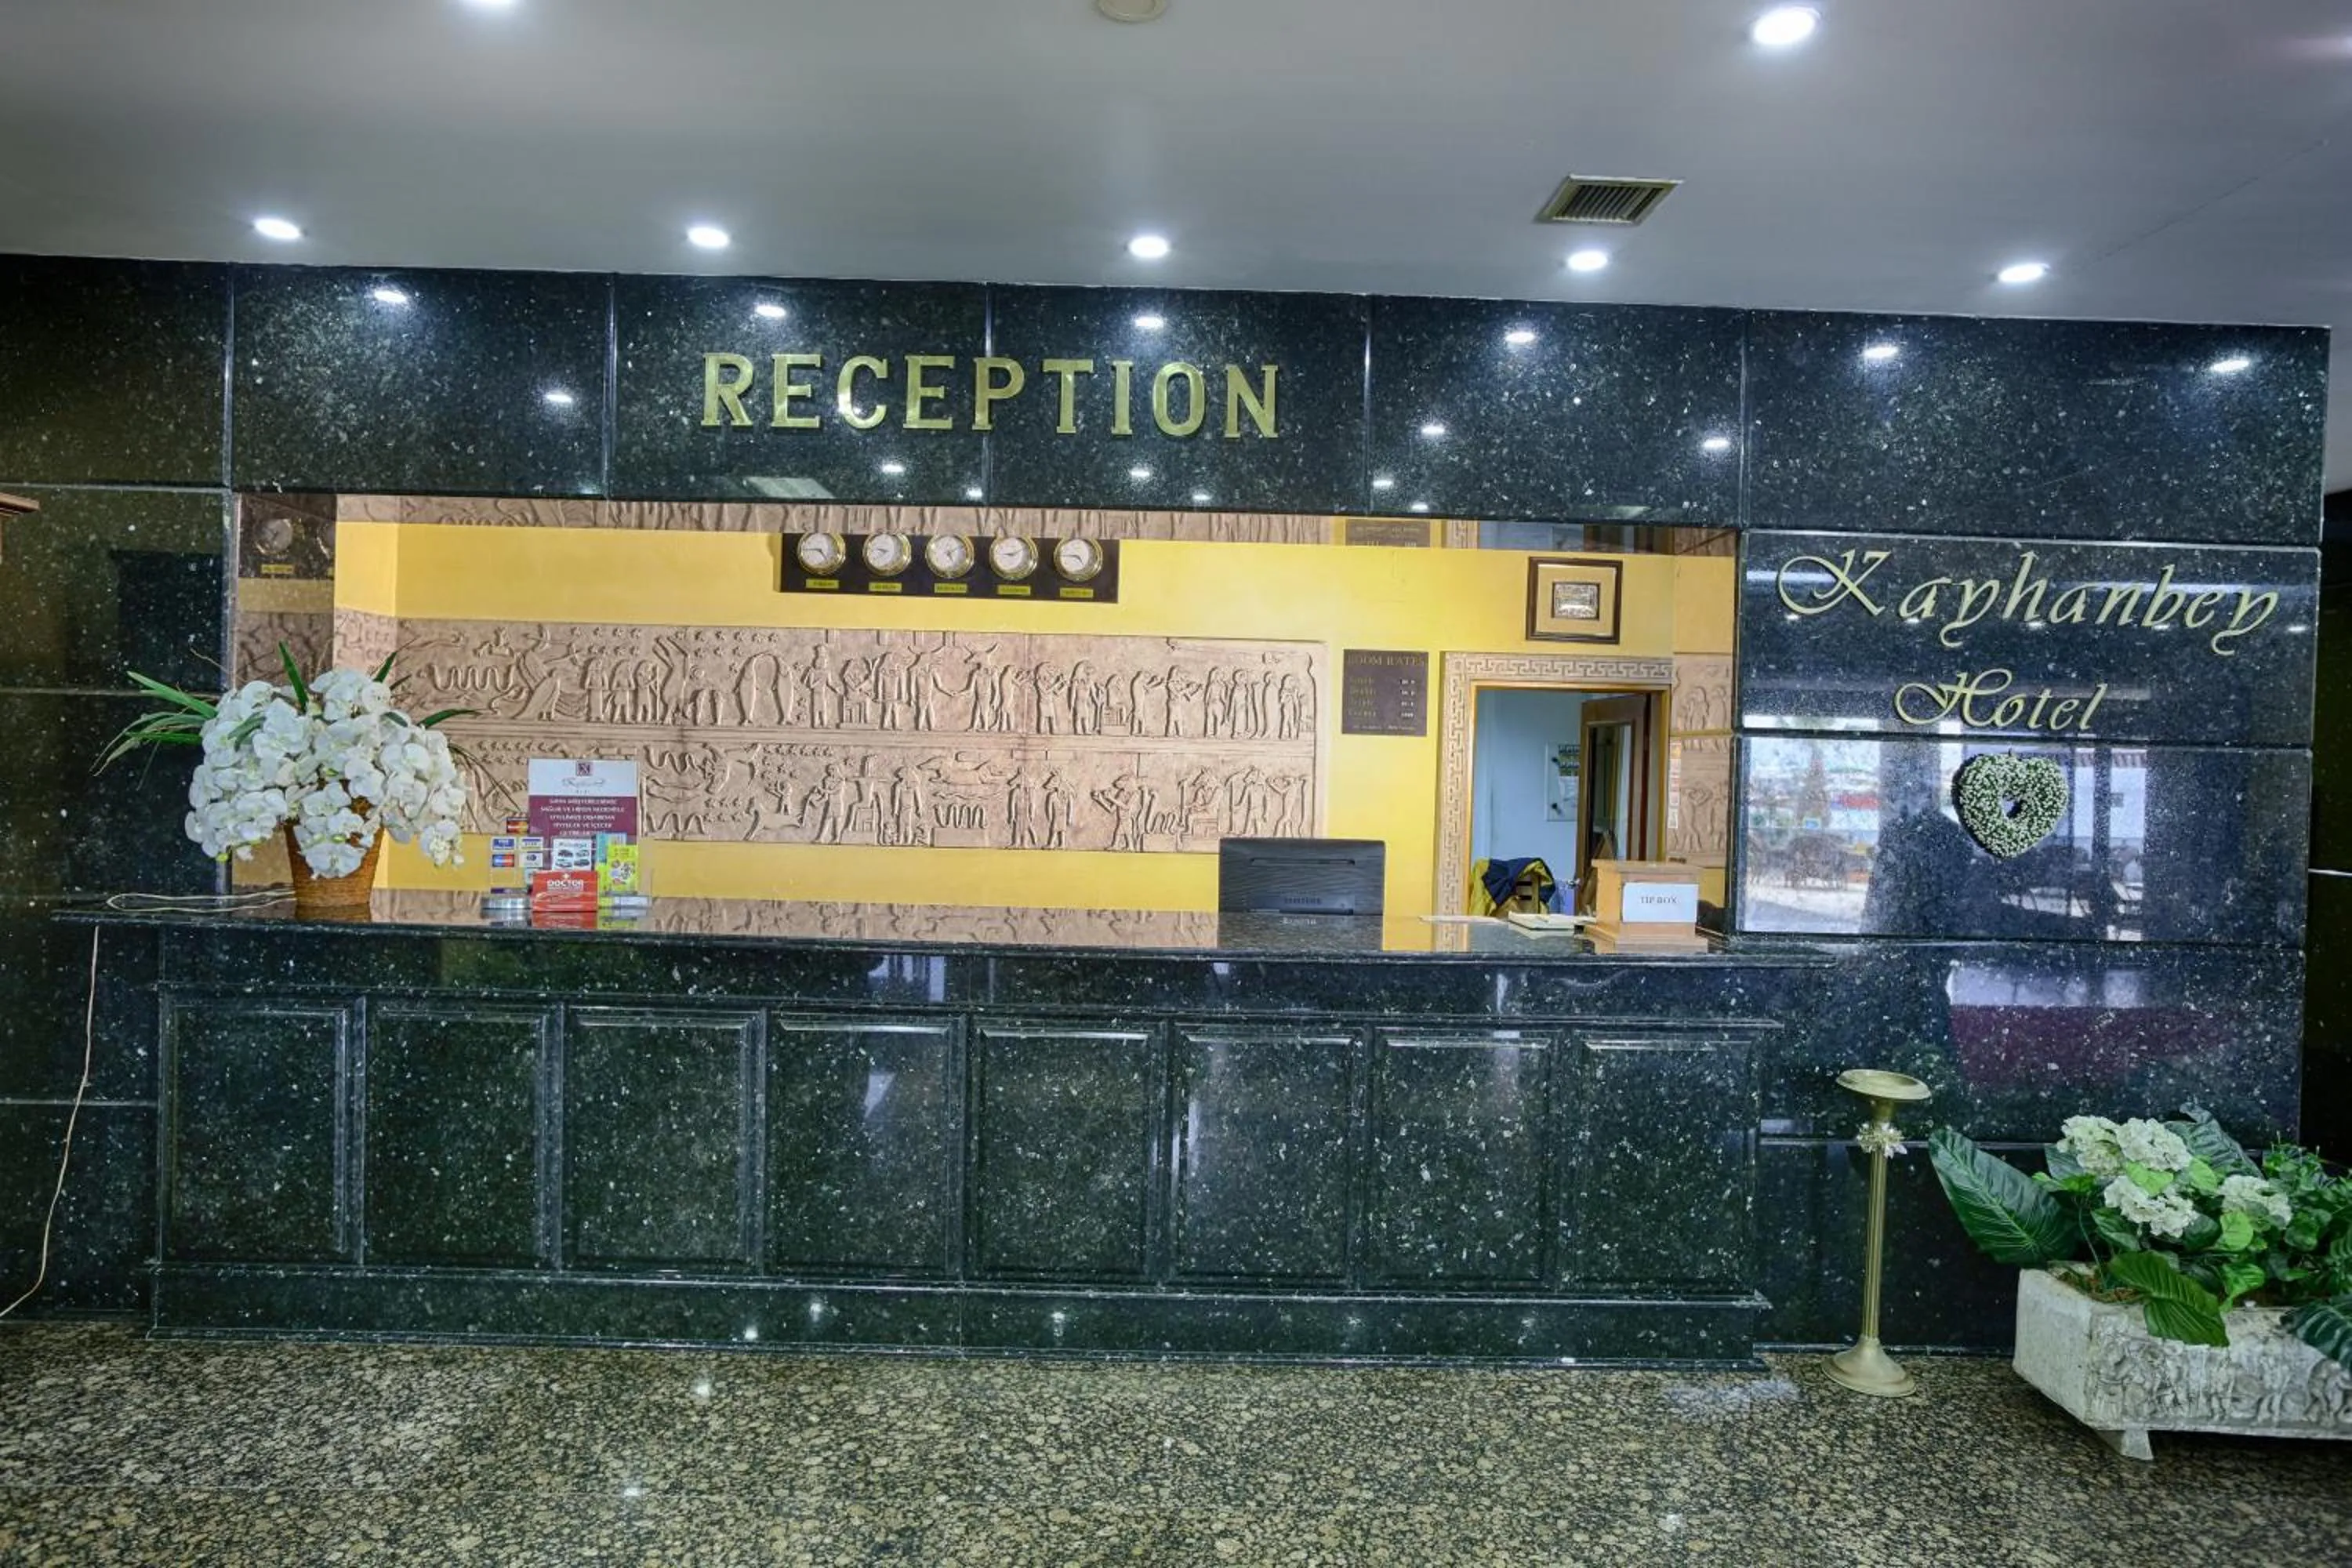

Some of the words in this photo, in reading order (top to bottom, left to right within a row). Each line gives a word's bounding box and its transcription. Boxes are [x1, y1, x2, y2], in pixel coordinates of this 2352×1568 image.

[701, 352, 1279, 439] RECEPTION
[1777, 549, 2278, 655] Kayhanbey
[1894, 668, 2108, 731] Hotel
